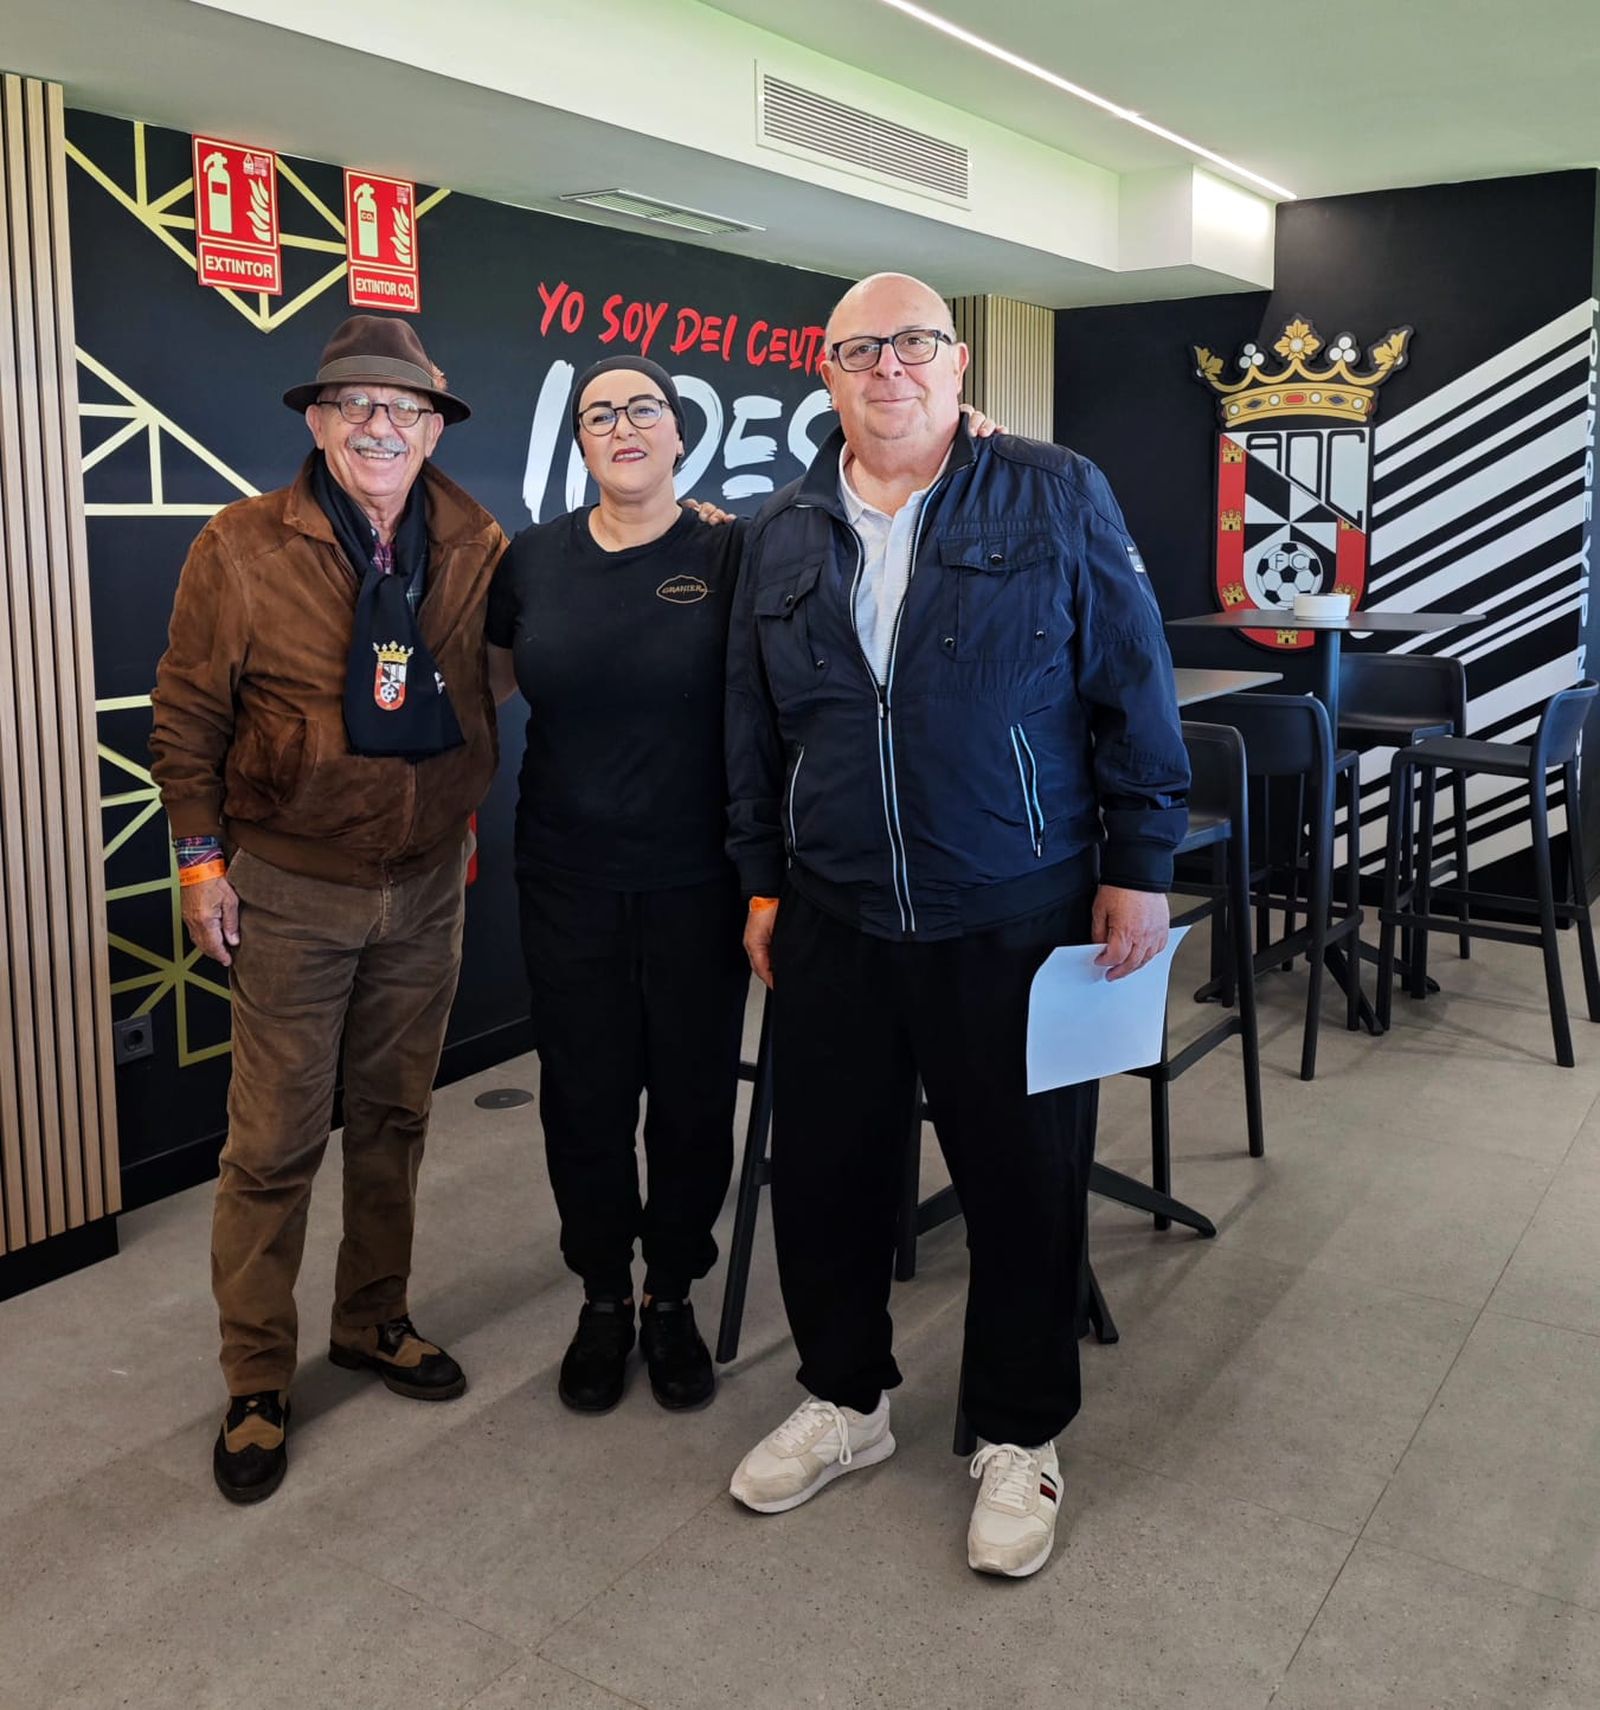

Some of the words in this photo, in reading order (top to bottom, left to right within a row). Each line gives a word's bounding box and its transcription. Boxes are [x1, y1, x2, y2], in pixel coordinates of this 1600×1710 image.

[205, 255, 273, 279] EXTINTOR
[356, 278, 397, 296] EXTINTOR
[537, 281, 585, 337] YO
[598, 293, 669, 357] SOY
[1584, 297, 1599, 521] LOUNGE
[1274, 553, 1312, 571] FC
